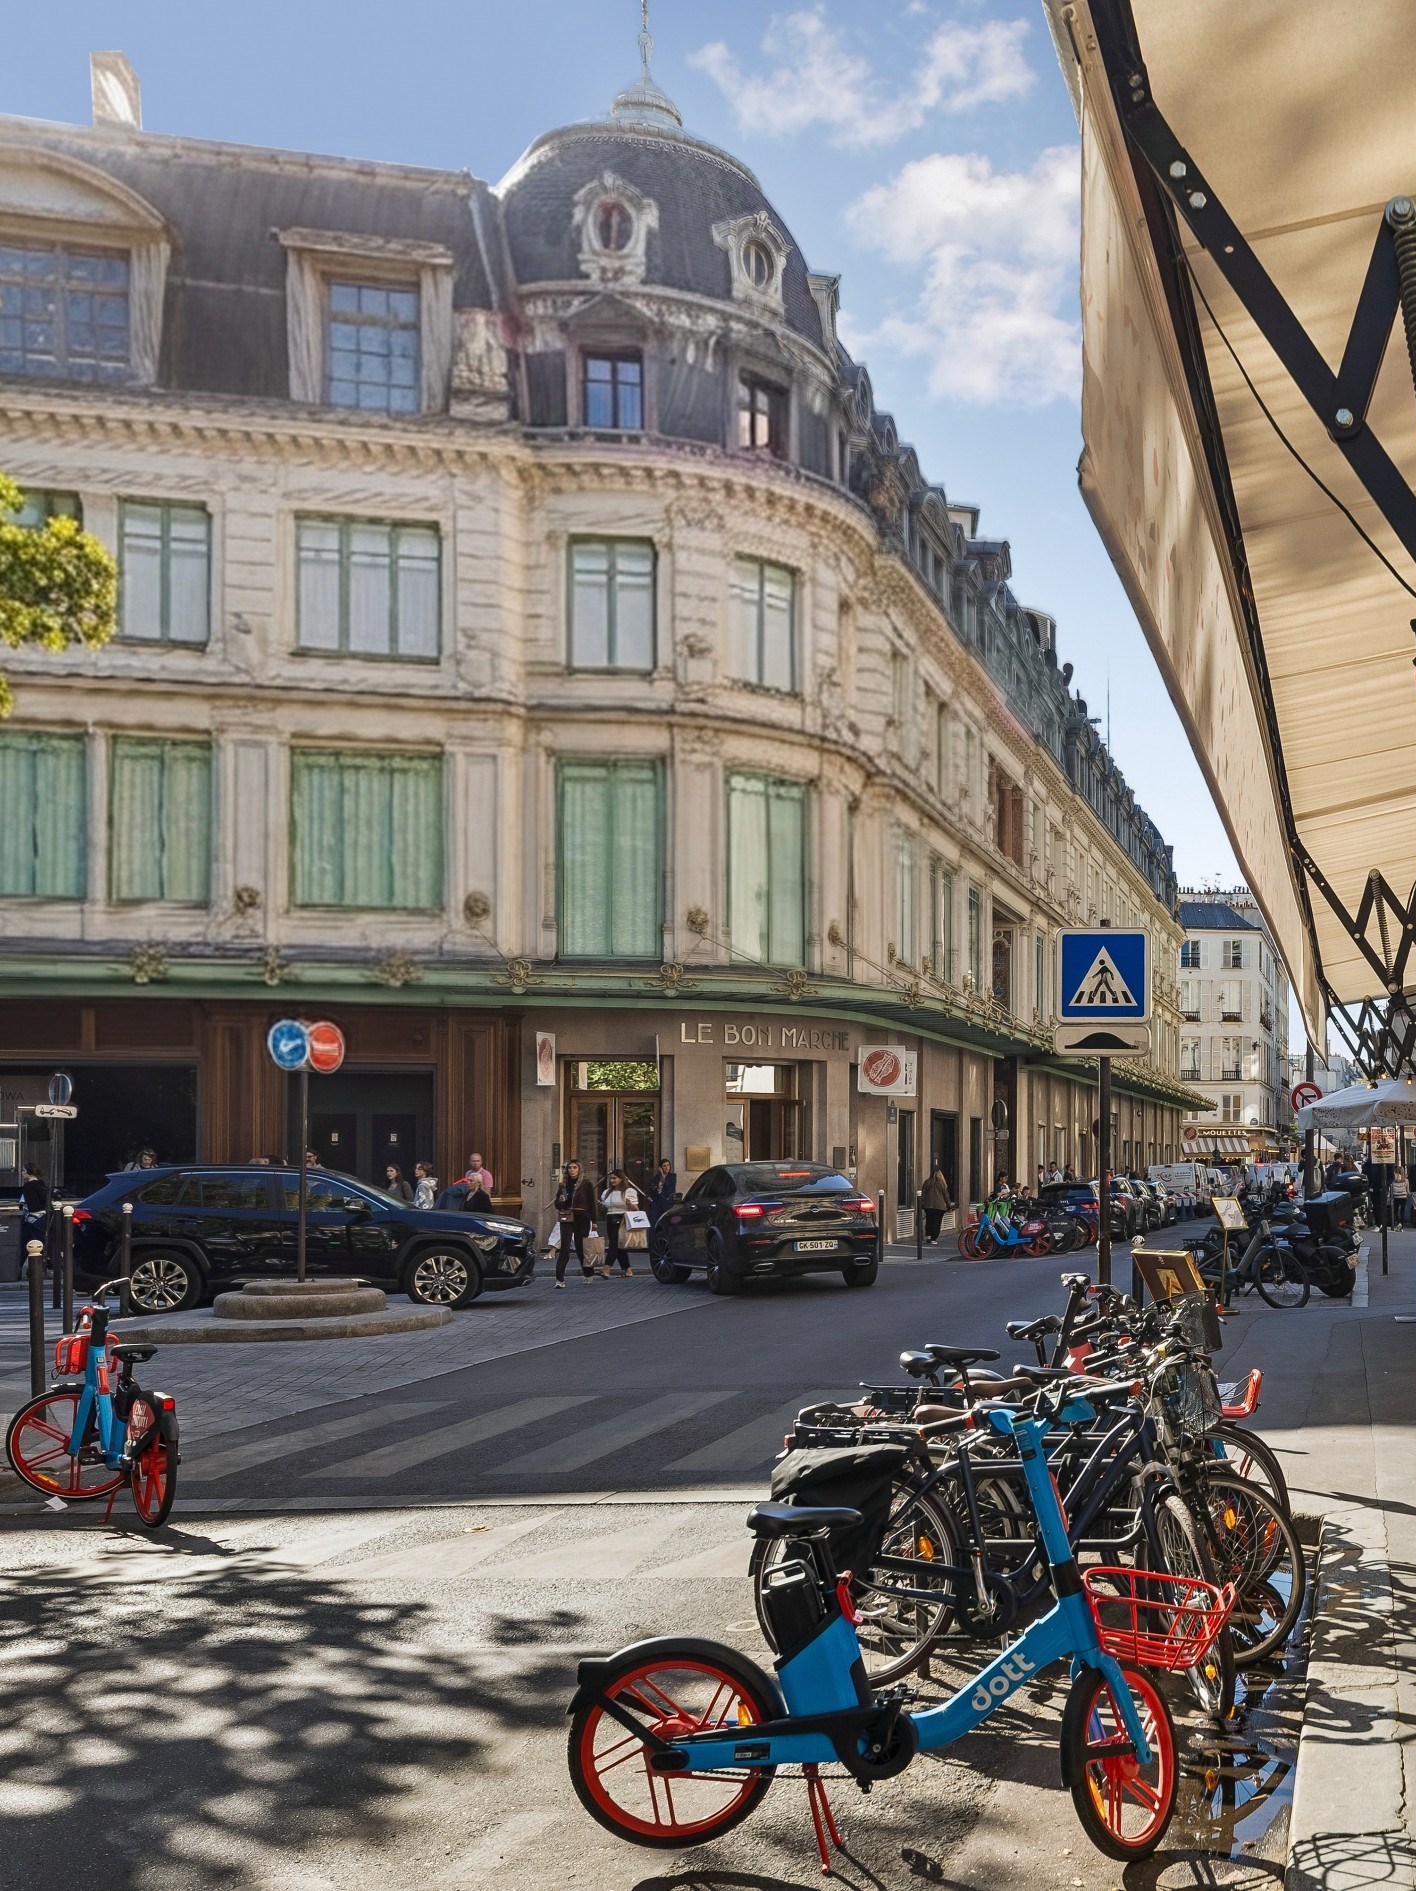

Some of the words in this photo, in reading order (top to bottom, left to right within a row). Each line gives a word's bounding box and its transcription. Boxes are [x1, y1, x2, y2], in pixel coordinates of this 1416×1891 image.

[681, 1022, 714, 1045] LE
[724, 1023, 772, 1046] BON
[971, 1652, 1036, 1711] dott
